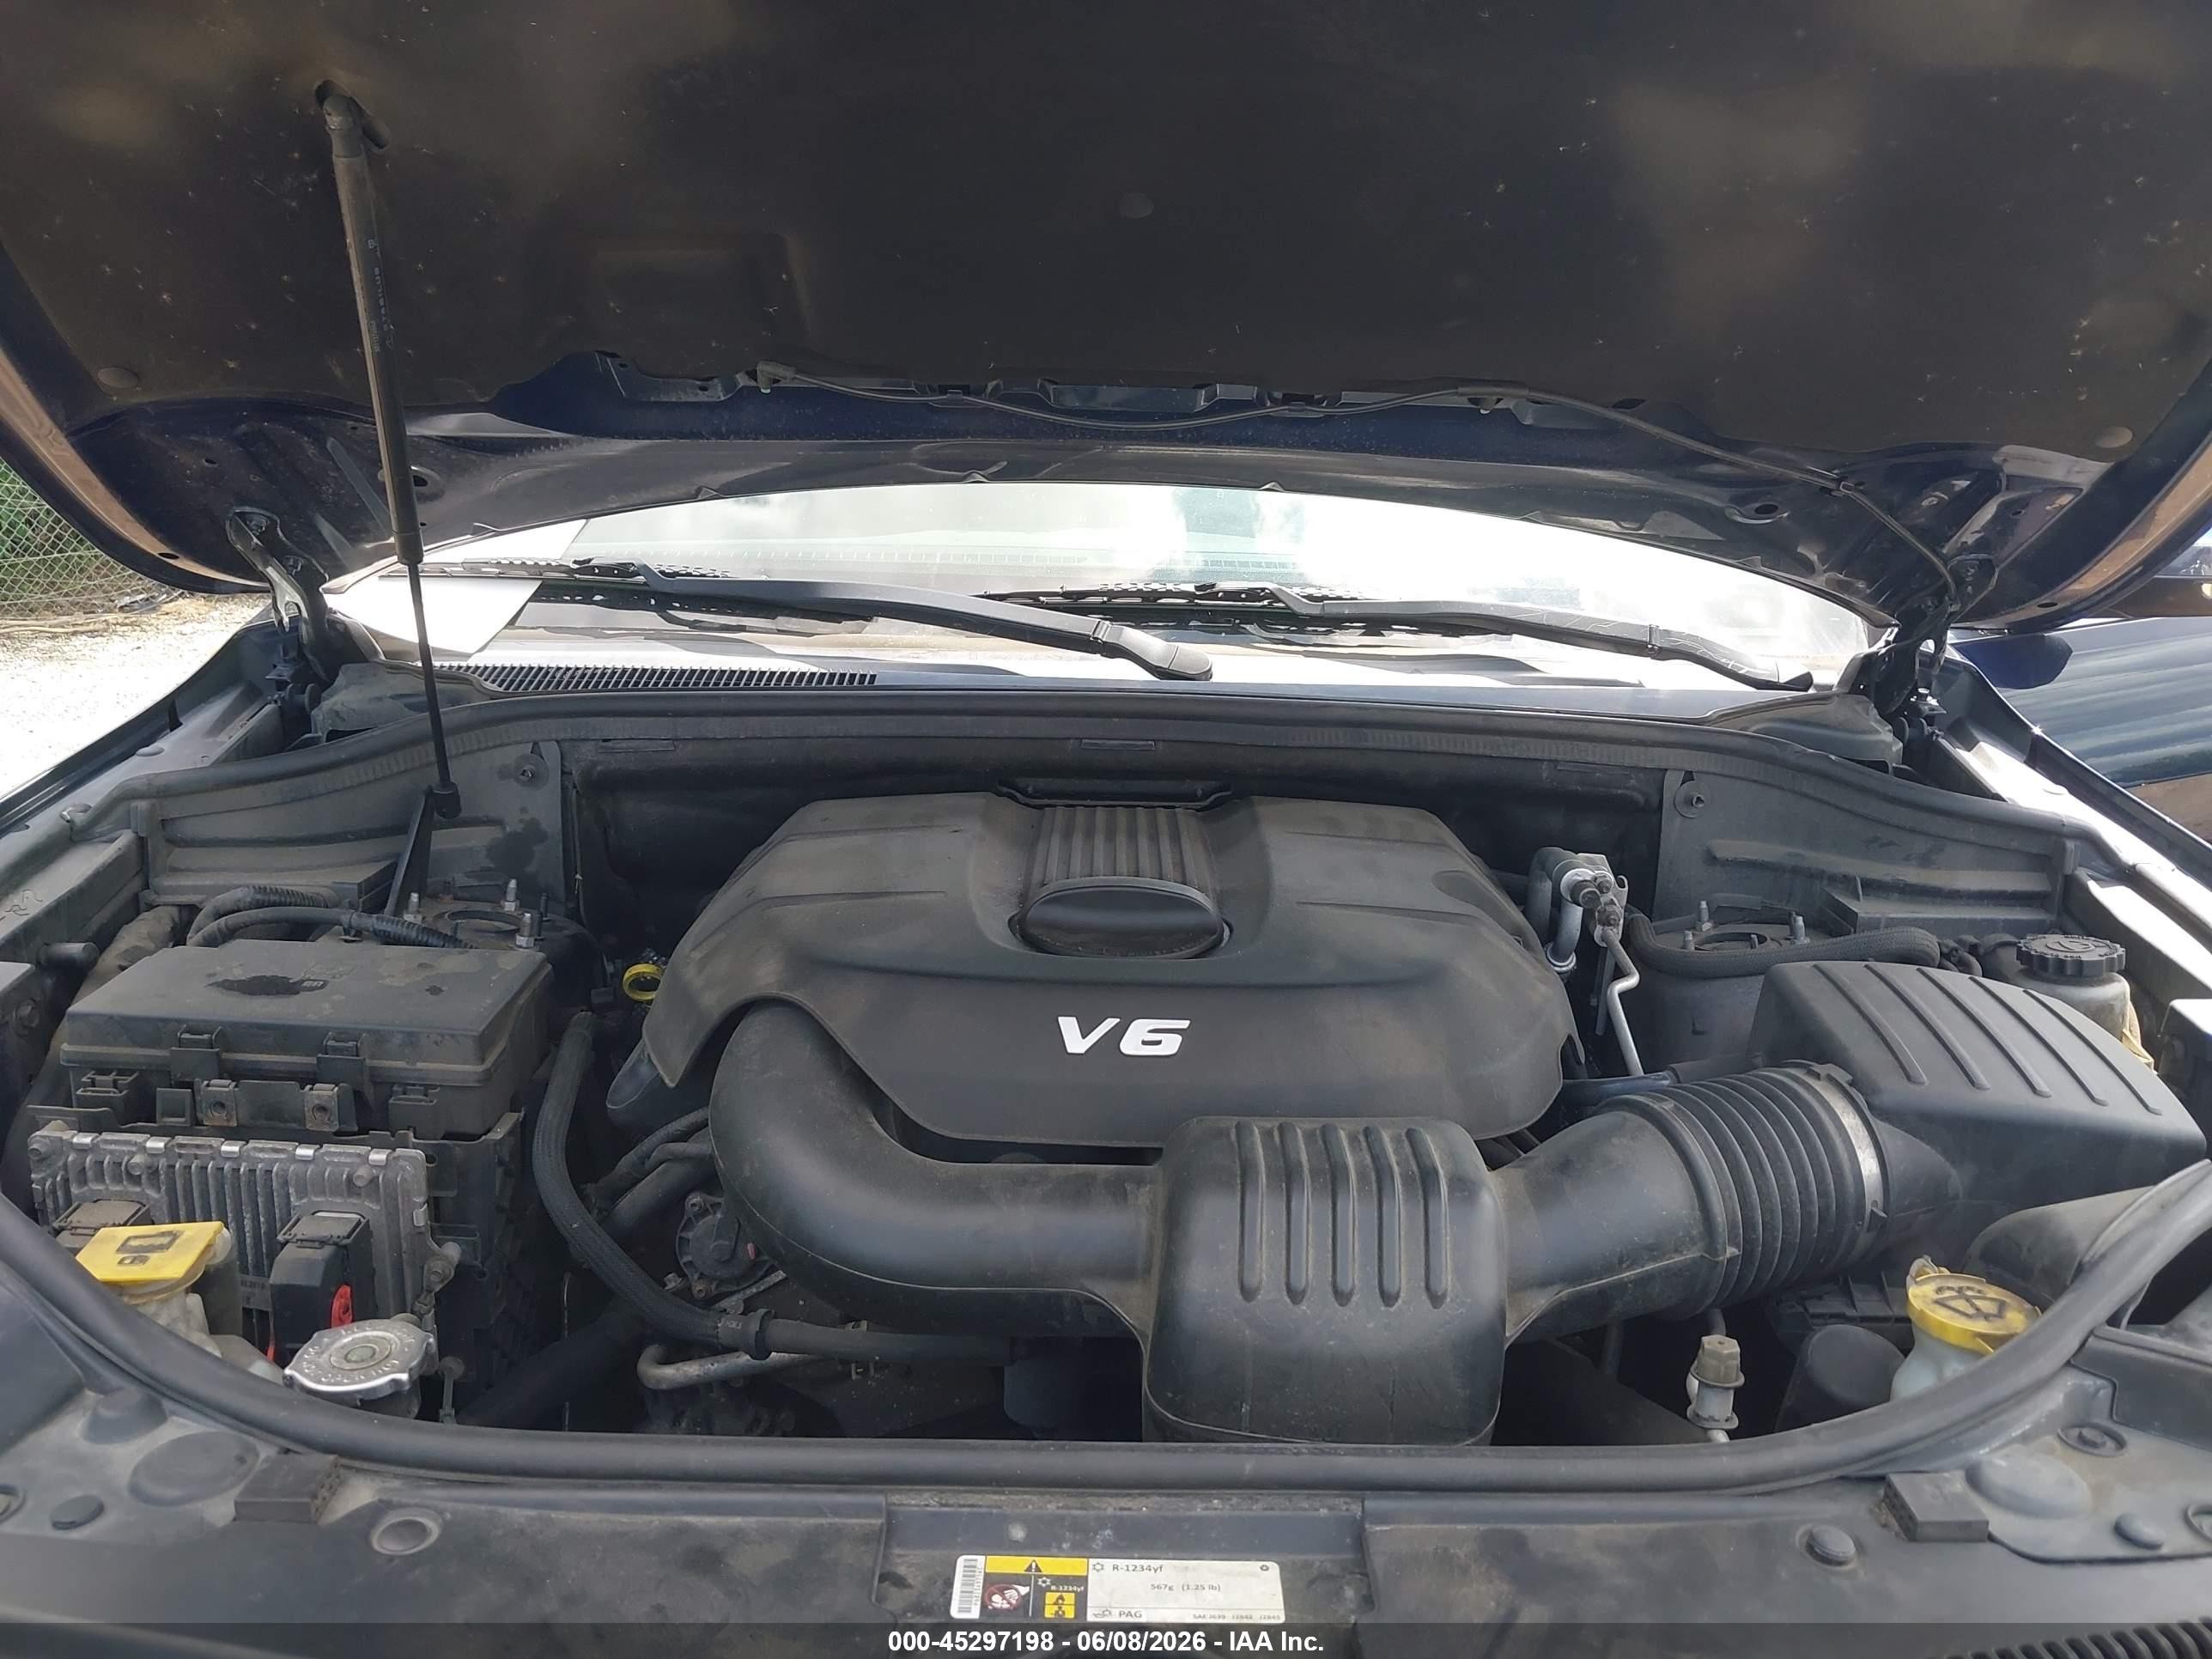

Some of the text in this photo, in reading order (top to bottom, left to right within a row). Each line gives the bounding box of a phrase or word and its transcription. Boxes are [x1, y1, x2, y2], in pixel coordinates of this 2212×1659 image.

[1058, 1016, 1190, 1055] V6
[1112, 1564, 1163, 1574] R-1234yf
[1151, 1583, 1174, 1592] 567g
